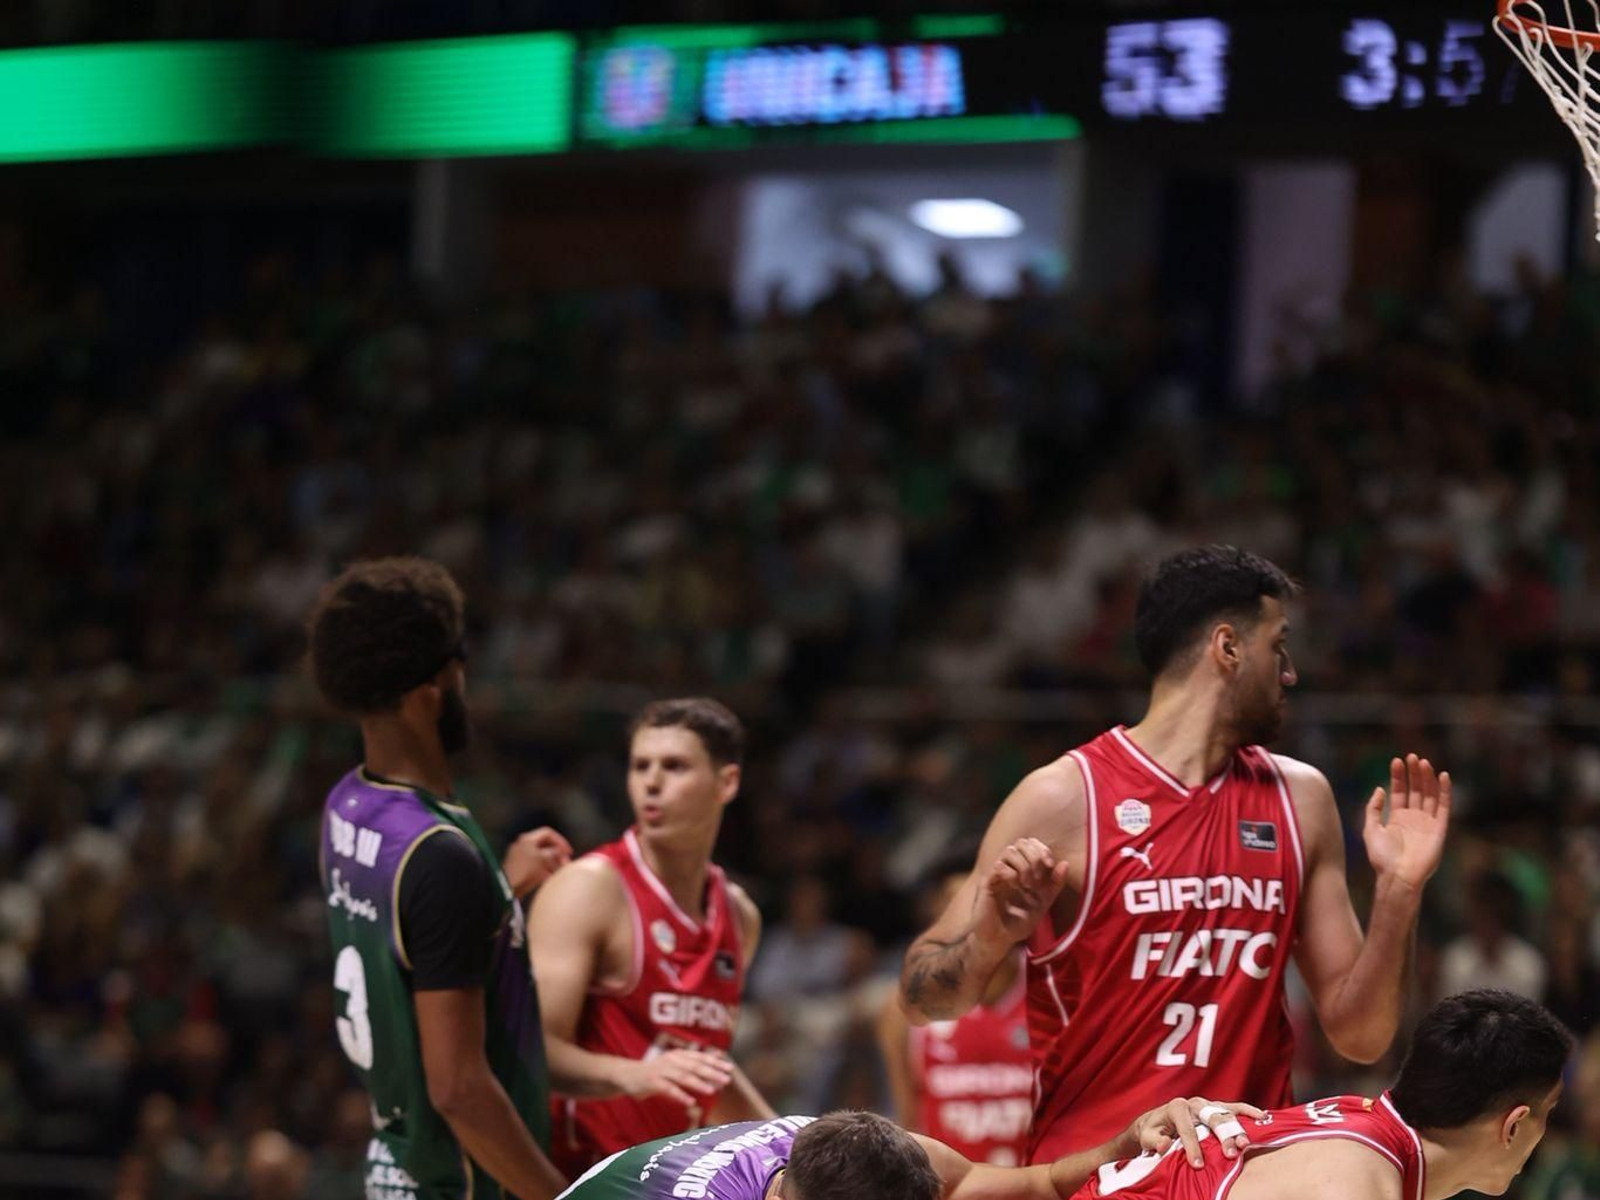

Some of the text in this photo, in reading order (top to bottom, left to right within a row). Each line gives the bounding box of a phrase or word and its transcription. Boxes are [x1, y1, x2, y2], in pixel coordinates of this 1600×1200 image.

[1102, 18, 1227, 120] 53
[1123, 874, 1286, 916] GIRONA
[1130, 928, 1278, 981] FIATC
[334, 945, 374, 1071] 3
[1155, 1001, 1219, 1069] 21
